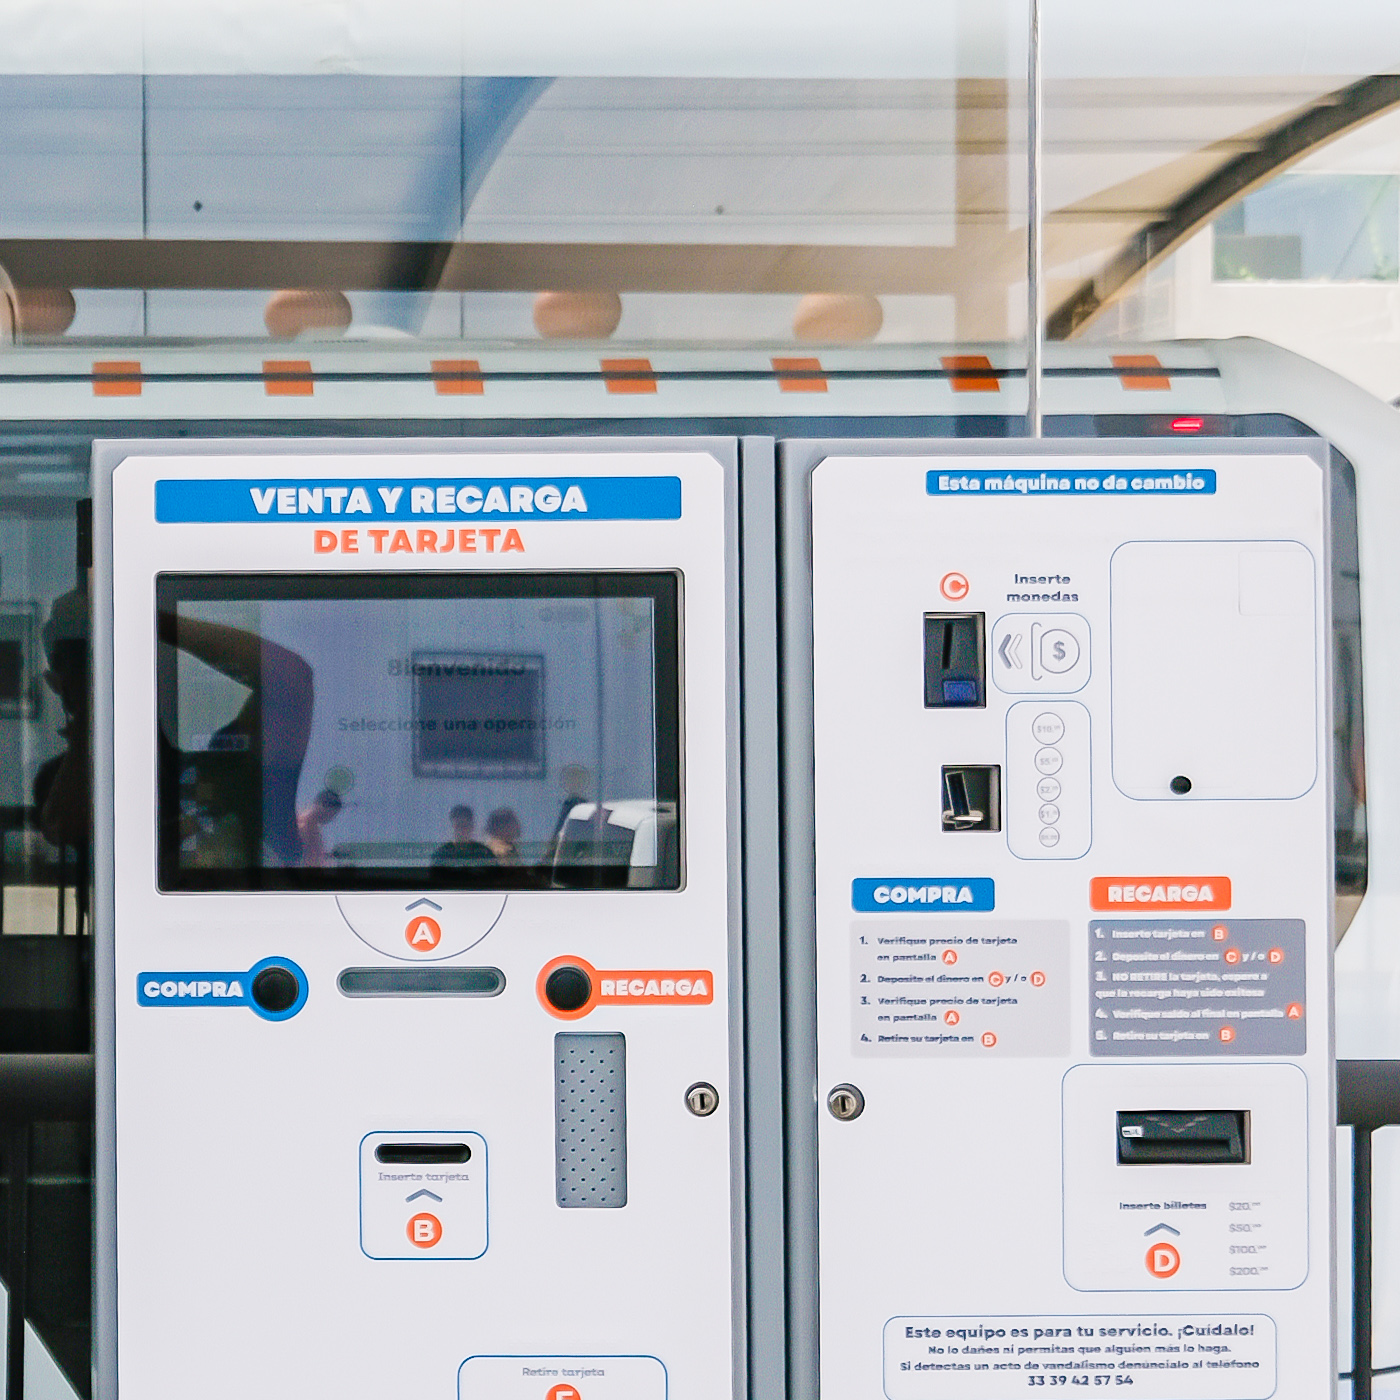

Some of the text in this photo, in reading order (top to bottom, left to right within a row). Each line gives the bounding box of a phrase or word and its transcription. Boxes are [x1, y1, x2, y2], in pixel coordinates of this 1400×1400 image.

[938, 473, 1205, 492] Esta máquina no da cambio
[250, 485, 587, 515] VENTA Y RECARGA
[314, 529, 525, 553] DE TARJETA
[1015, 574, 1070, 584] Inserte
[1007, 591, 1078, 601] monedas
[388, 657, 526, 677] Bienvenido
[338, 714, 577, 734] Seleccione una operación
[874, 886, 973, 904] COMPRA
[1108, 884, 1214, 902] RECARGA
[412, 923, 434, 944] A
[860, 936, 868, 944] 1.
[878, 937, 927, 945] Verifique
[929, 936, 963, 946] precio
[981, 936, 1017, 946] tarjeta
[893, 953, 936, 962] pantalla
[860, 973, 870, 983] 2.
[878, 975, 924, 983] Deposite
[144, 981, 244, 998] COMPRA
[601, 979, 708, 996] RECARGA
[861, 996, 870, 1005] 3.
[878, 996, 927, 1006] Verifique
[929, 996, 964, 1006] precio
[981, 996, 1018, 1006] tarjeta
[893, 1013, 937, 1022] pantalla
[861, 1033, 872, 1042] 4.
[878, 1034, 909, 1042] Retire
[924, 1034, 959, 1044] tarjeta
[379, 1172, 469, 1183] Inserte tarjeta
[1164, 1201, 1206, 1209] billetes
[413, 1219, 435, 1242] B
[1153, 1251, 1173, 1271] D
[906, 1327, 941, 1338] Este
[946, 1324, 1006, 1341] equipo
[1011, 1329, 1028, 1337] es
[1034, 1328, 1072, 1340] para
[1076, 1326, 1094, 1336] tu
[1099, 1323, 1173, 1337] servicio.
[929, 1346, 944, 1354] No
[948, 1346, 958, 1354] lo
[962, 1346, 999, 1354] dañes
[1003, 1344, 1014, 1353] ni
[1018, 1344, 1074, 1356] permitas
[1077, 1347, 1101, 1355] que
[1105, 1343, 1151, 1355] alguien
[1184, 1344, 1195, 1352] lo
[1198, 1344, 1231, 1354] haga.
[901, 1361, 911, 1371] Si
[914, 1362, 970, 1371] detectas
[1024, 1361, 1039, 1370] de
[1042, 1361, 1115, 1369] vandalismo
[1193, 1360, 1202, 1368] al
[523, 1367, 604, 1379] Retire tarjeta
[1028, 1375, 1133, 1386] 33 39 42 57 54
